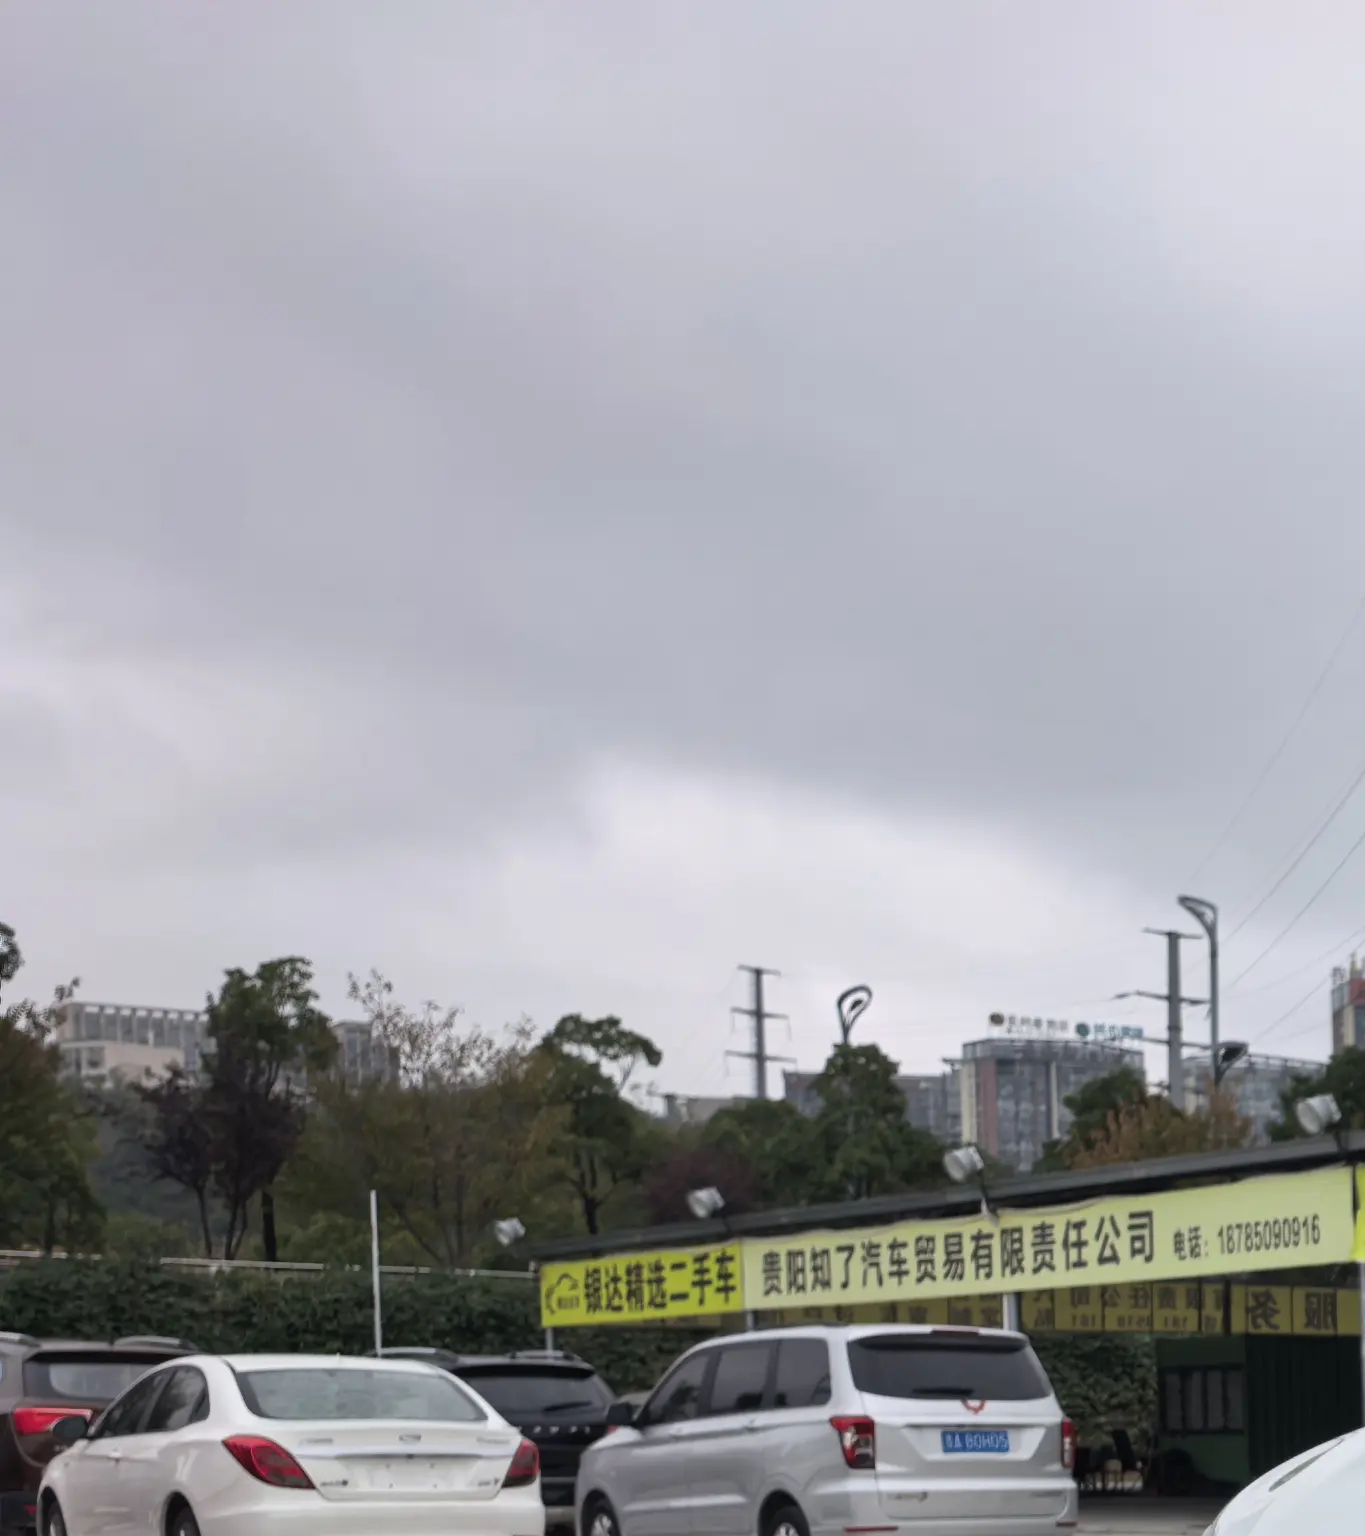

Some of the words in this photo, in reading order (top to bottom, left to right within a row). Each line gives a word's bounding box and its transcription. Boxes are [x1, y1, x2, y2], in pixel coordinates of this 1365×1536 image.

[762, 1210, 1154, 1297] 贵阳知了汽车贸易有限责任公司
[1217, 1213, 1321, 1255] 18785090916
